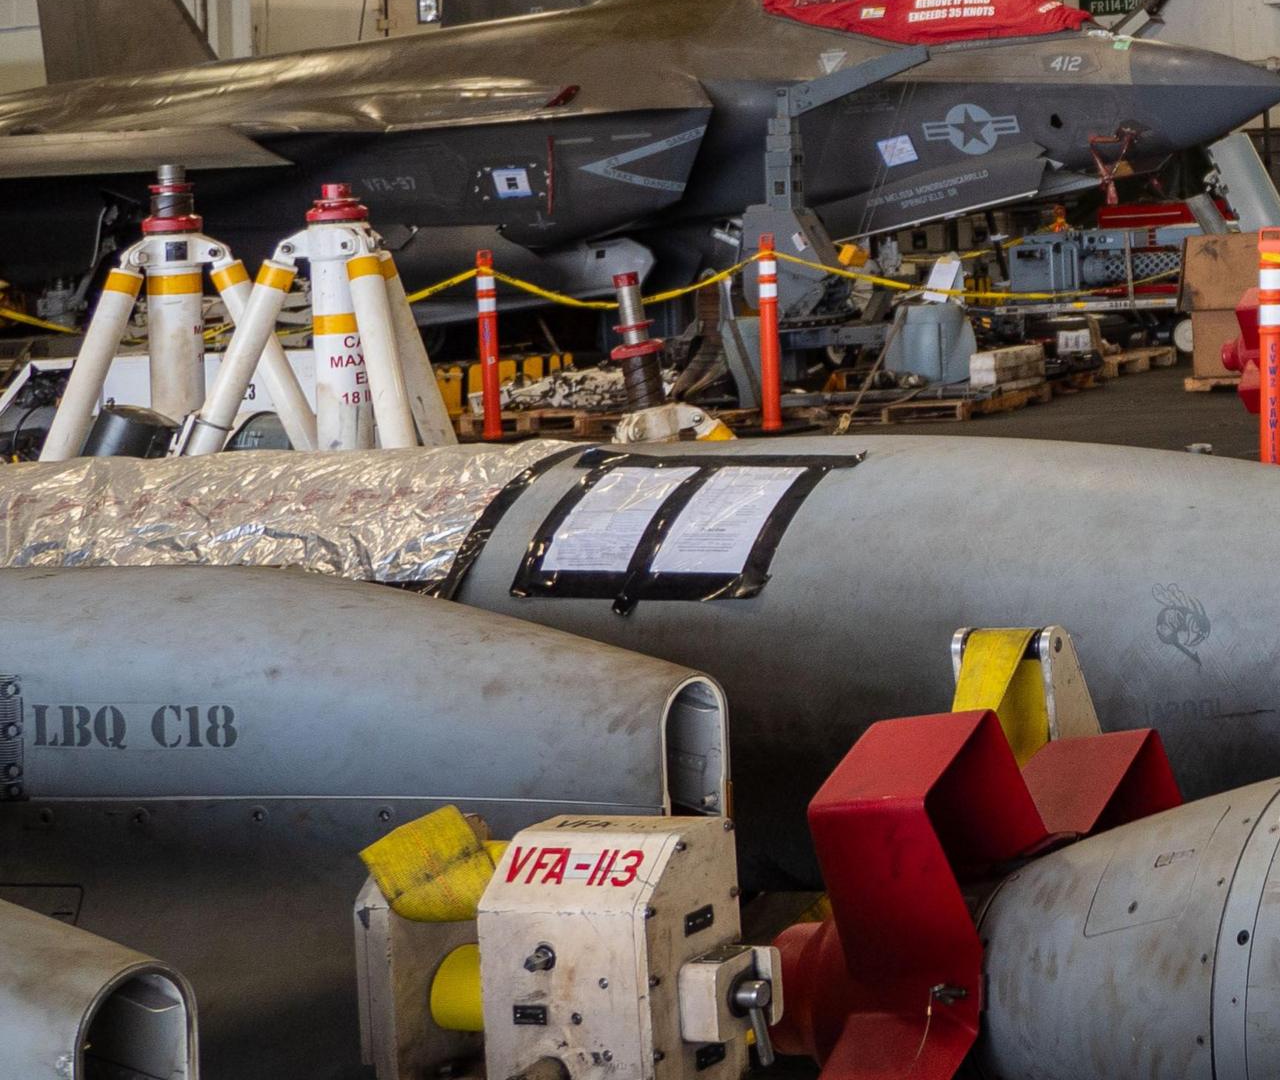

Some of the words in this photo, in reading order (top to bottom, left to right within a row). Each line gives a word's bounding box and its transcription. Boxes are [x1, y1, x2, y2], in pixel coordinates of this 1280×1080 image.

[908, 10, 947, 22] EXCEEDS
[949, 8, 961, 18] 35
[962, 6, 995, 17] KNOTS
[1050, 56, 1082, 71] 412
[342, 392, 360, 405] 18
[32, 705, 127, 749] LBQ
[152, 705, 238, 748] C18
[506, 846, 645, 887] VFA-113
